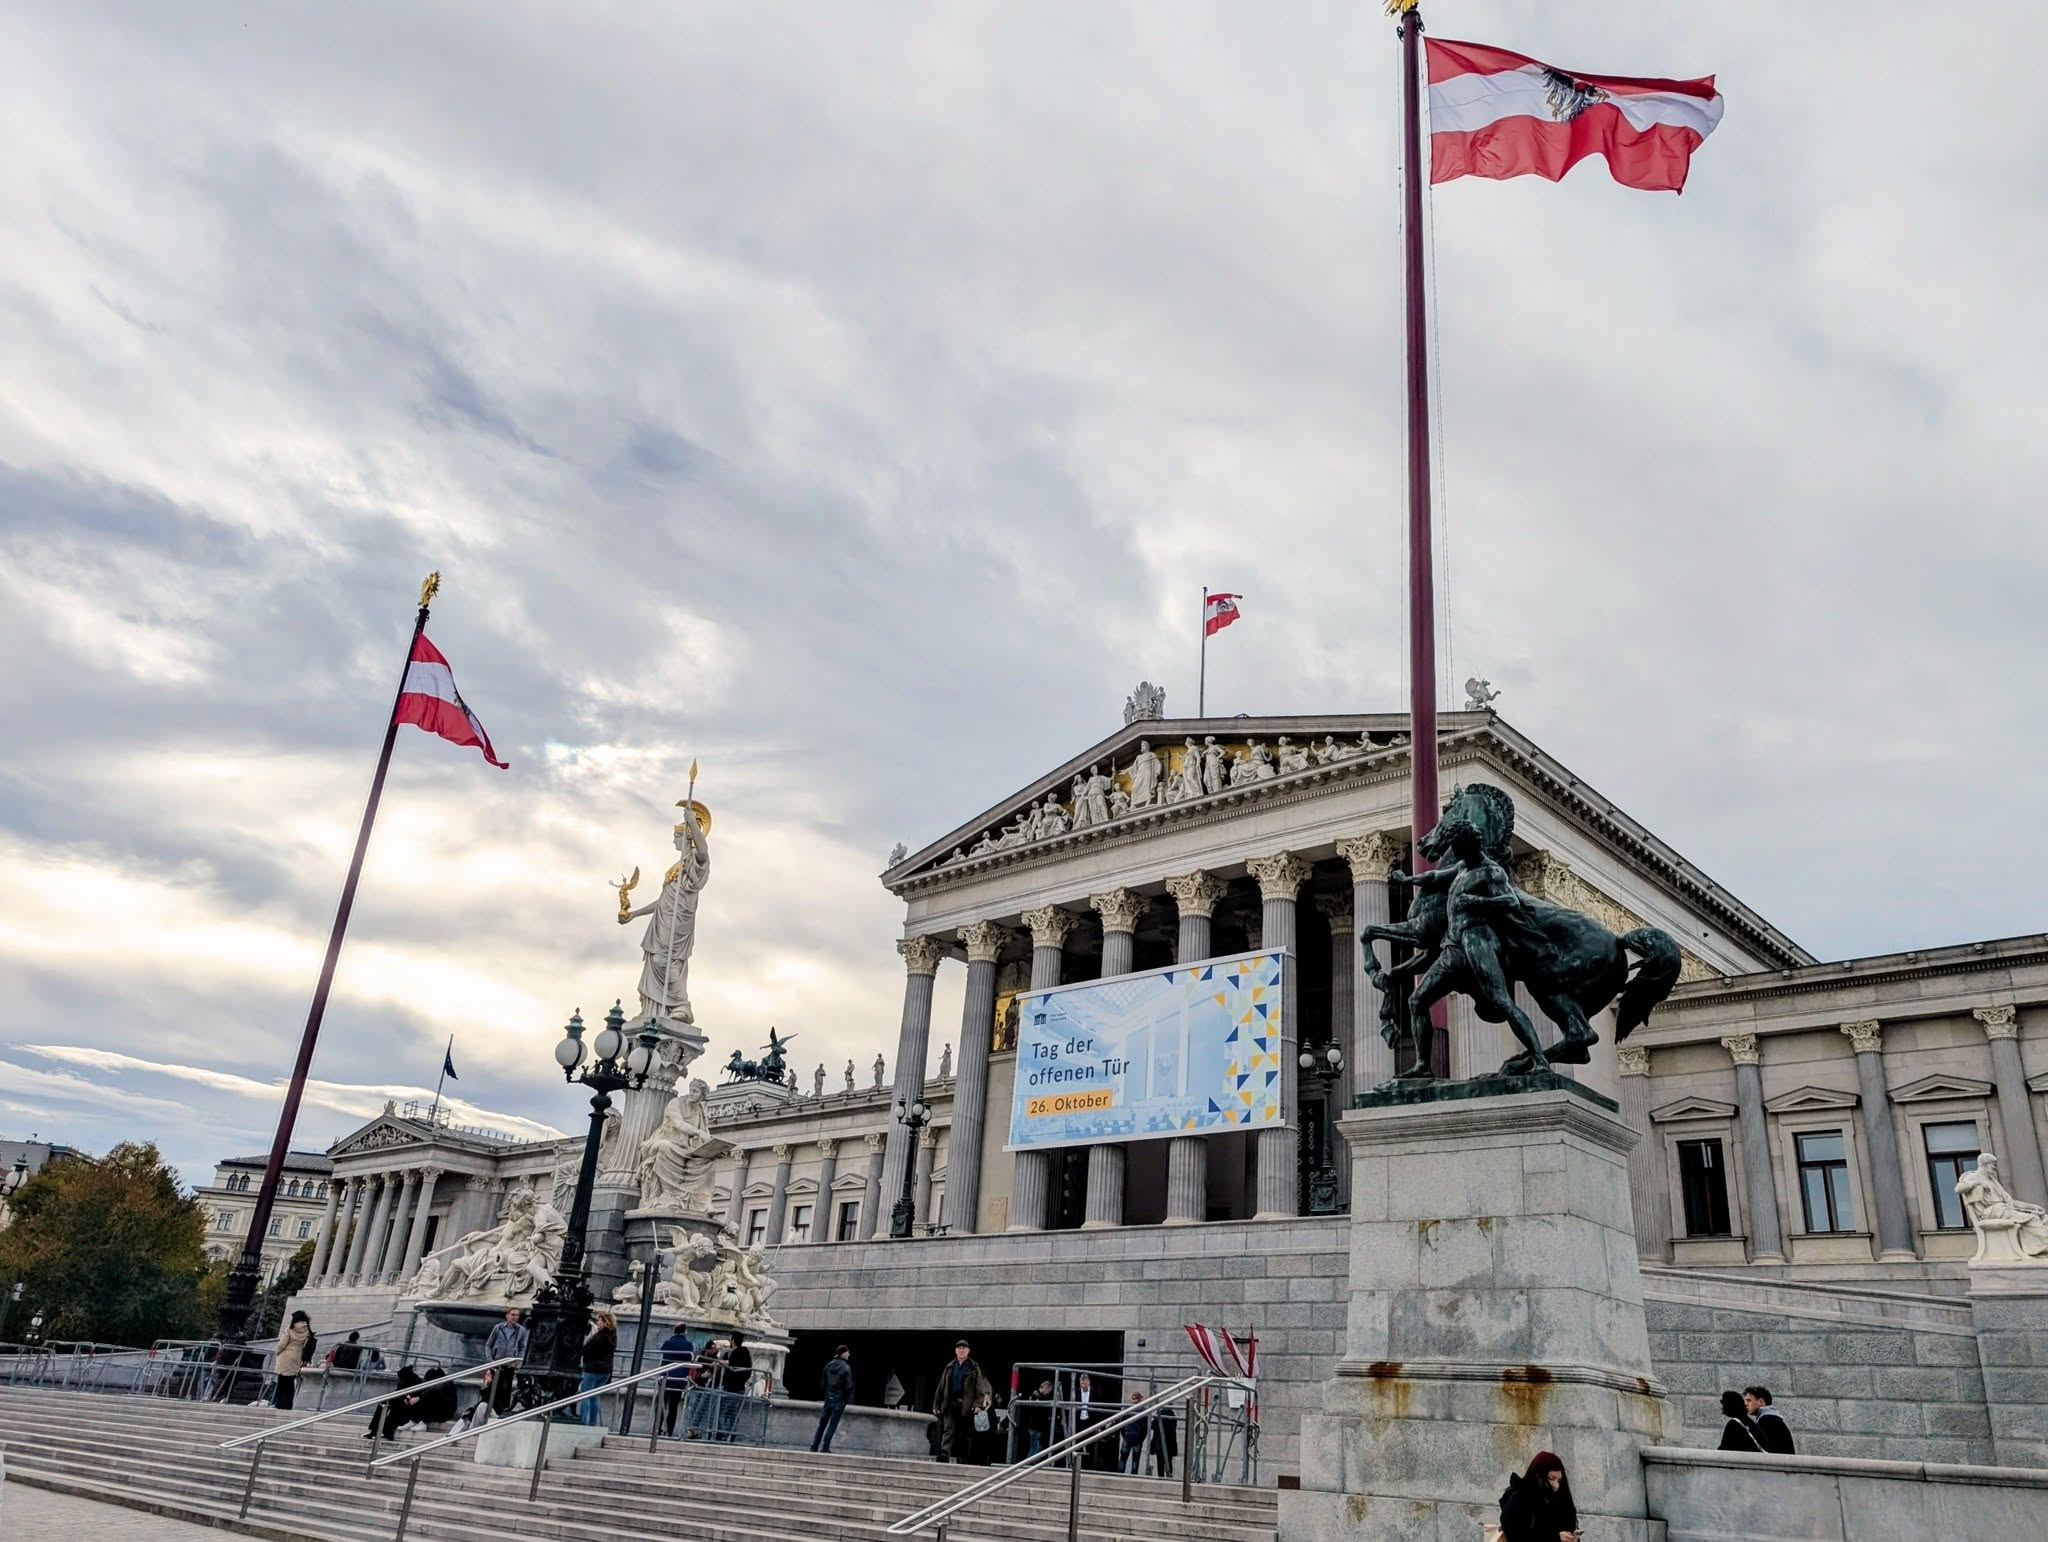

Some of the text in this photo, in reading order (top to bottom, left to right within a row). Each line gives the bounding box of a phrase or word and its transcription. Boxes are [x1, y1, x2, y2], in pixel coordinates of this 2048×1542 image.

[1032, 1037, 1094, 1060] Tag der
[1029, 1058, 1131, 1086] offenen Tür
[1030, 1094, 1108, 1114] 26. Oktober
